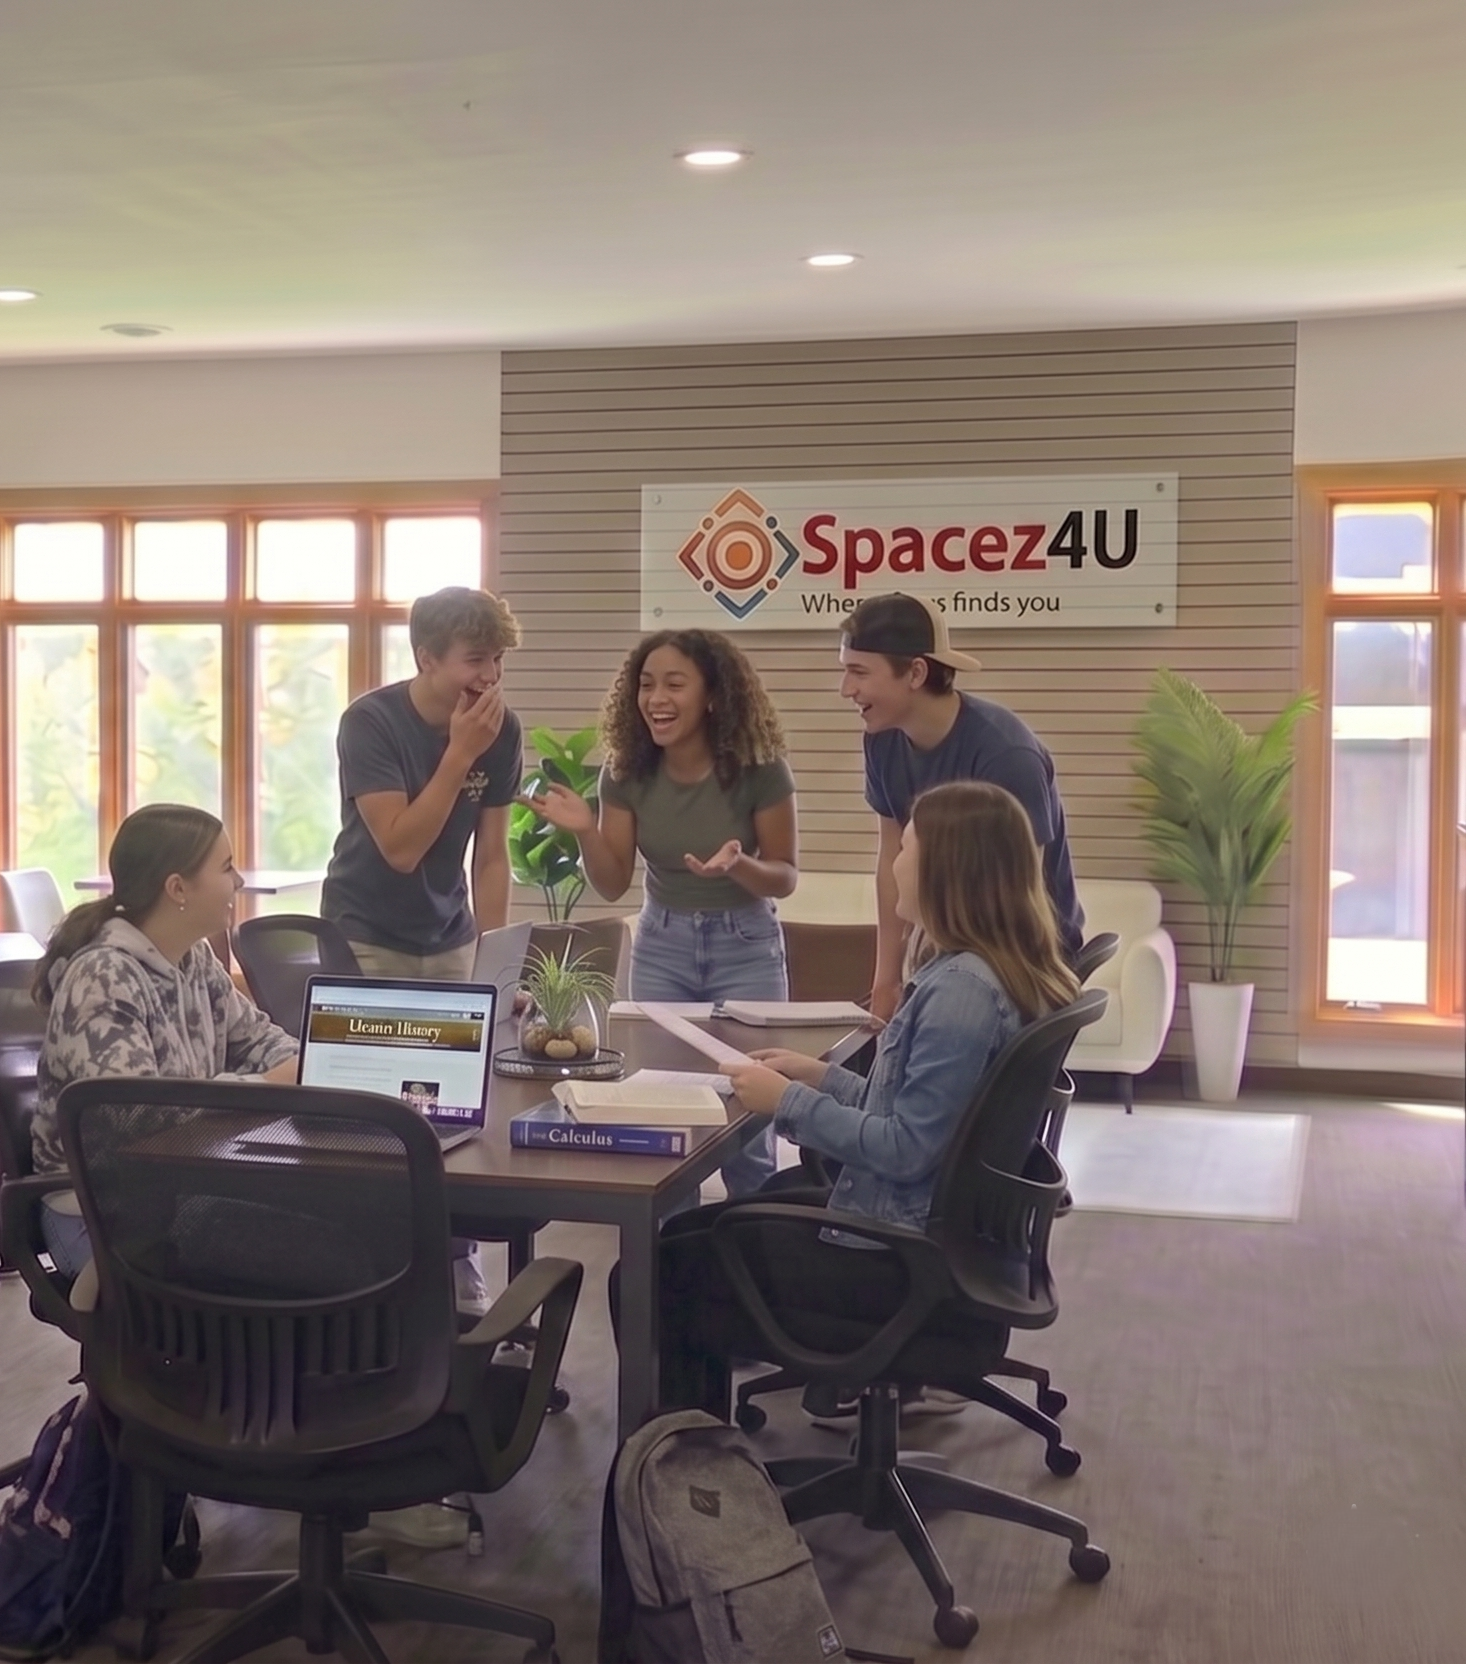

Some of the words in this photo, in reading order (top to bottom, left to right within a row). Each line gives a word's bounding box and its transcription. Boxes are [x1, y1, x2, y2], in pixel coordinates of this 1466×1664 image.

[802, 508, 1139, 590] Spacez4U
[801, 592, 864, 613] Wher
[953, 591, 1010, 612] finds
[1016, 596, 1060, 618] you
[548, 1128, 614, 1146] Calculus
